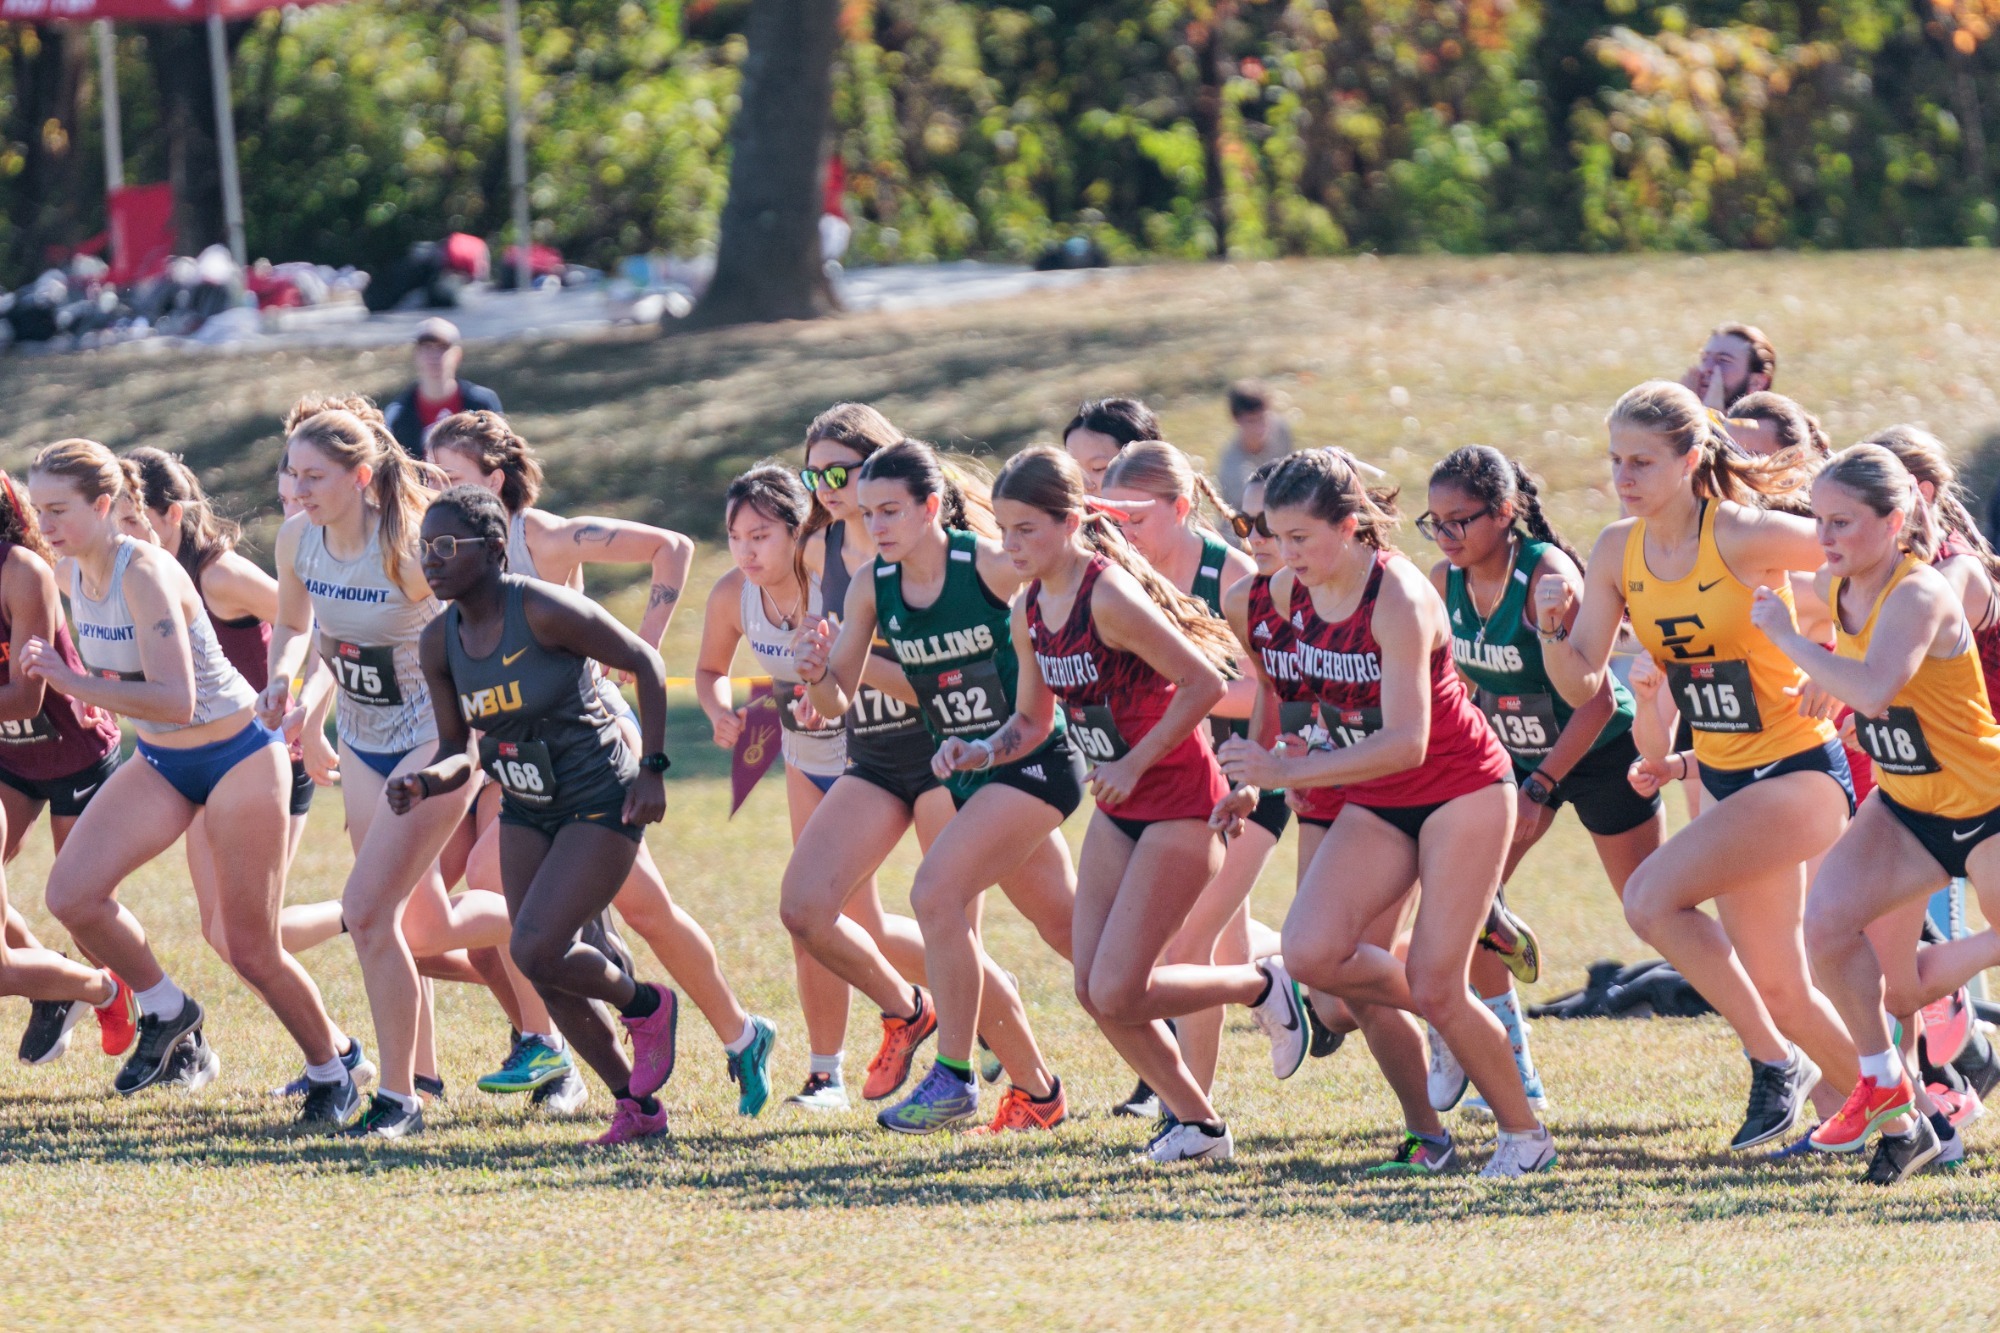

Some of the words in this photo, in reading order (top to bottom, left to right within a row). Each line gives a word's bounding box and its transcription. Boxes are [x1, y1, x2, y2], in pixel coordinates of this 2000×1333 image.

[78, 621, 134, 641] ARYMOUNT
[1654, 613, 1716, 660] E
[331, 656, 382, 695] 175
[938, 669, 963, 689] SNAP
[1261, 647, 1303, 681] LYNC
[1690, 662, 1715, 679] SNAP
[460, 680, 523, 722] MBU
[932, 687, 993, 724] 132
[1684, 683, 1741, 719] 115
[1070, 723, 1115, 758] 150
[1492, 714, 1547, 746] 135
[1865, 723, 1917, 761] 118
[492, 759, 545, 790] 168
